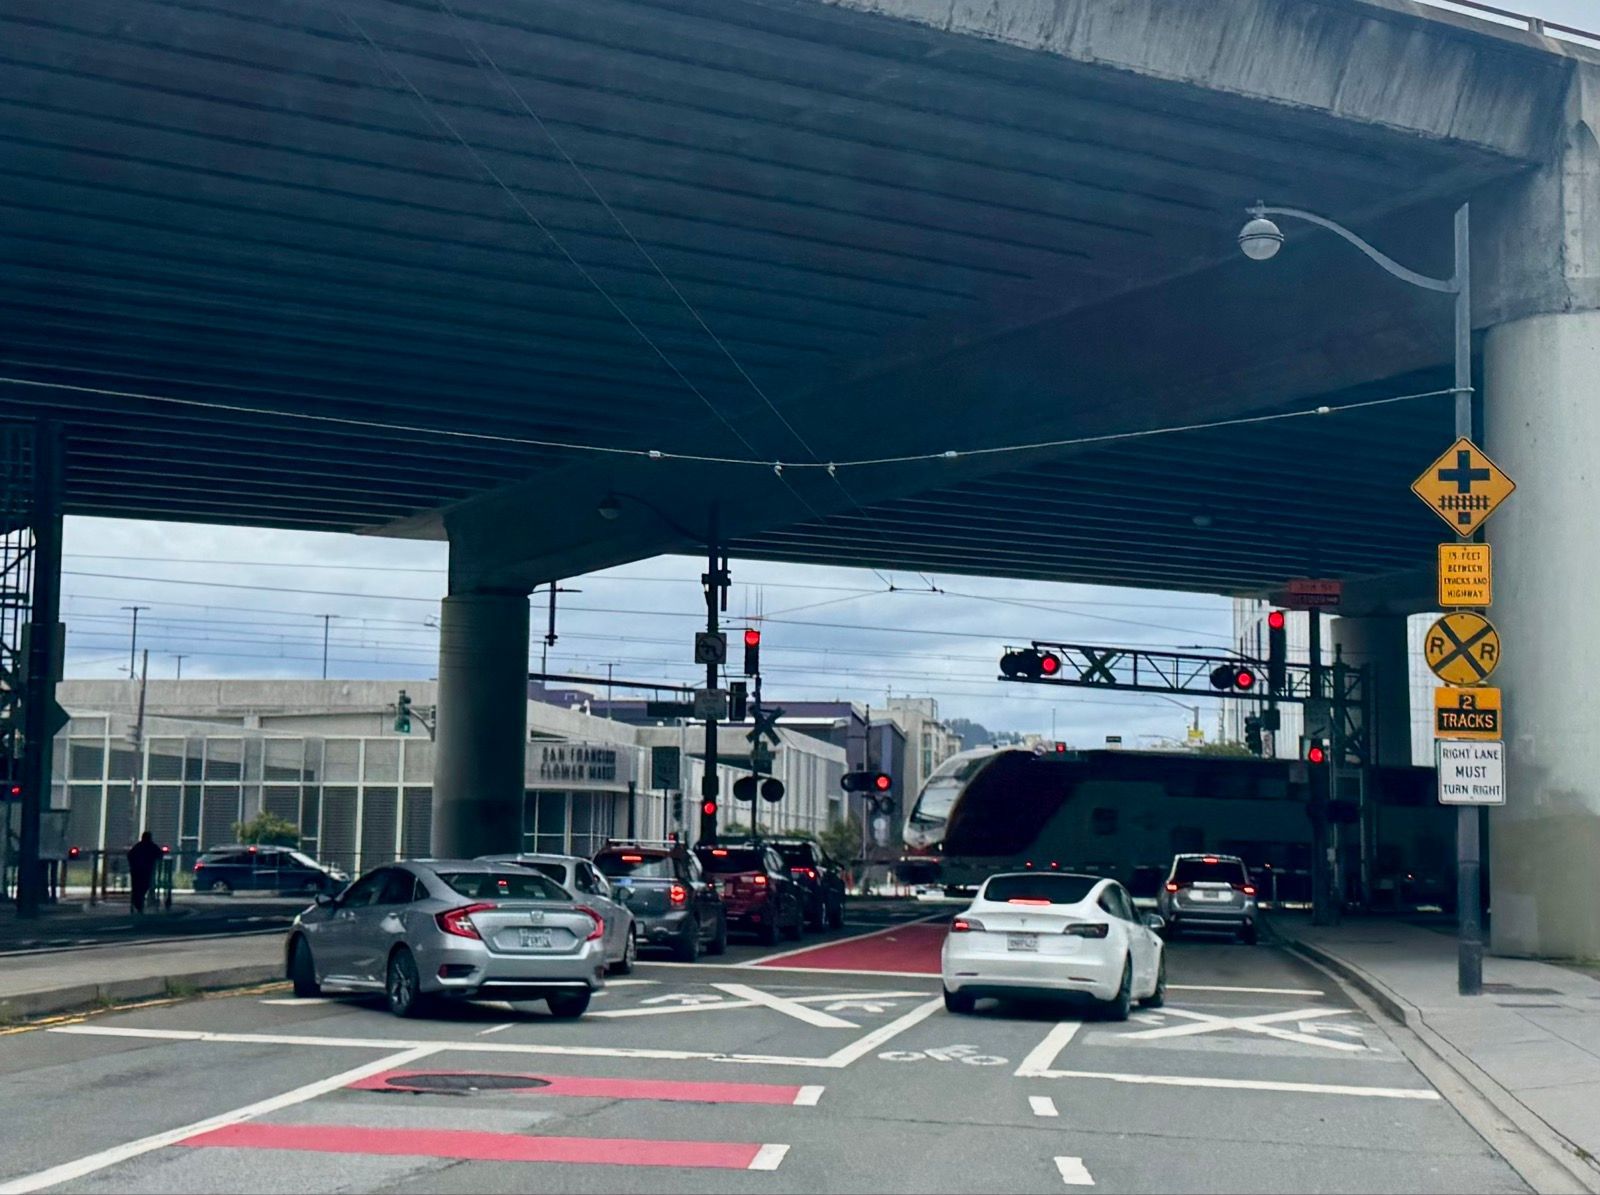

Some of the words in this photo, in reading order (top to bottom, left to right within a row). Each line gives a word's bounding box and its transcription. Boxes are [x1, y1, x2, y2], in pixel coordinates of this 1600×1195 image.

[1447, 564, 1483, 573] BETWEEN
[1444, 577, 1471, 585] TRACKS
[1472, 577, 1488, 585] AND
[1447, 589, 1483, 598] HIGHWAY
[1430, 636, 1445, 655] R
[1480, 642, 1496, 661] R
[1462, 695, 1473, 710] 2
[1441, 713, 1494, 728] TRACKS
[569, 747, 617, 764] FRANCI
[1442, 748, 1470, 760] RIGHT
[1474, 749, 1499, 760] LANE
[1455, 766, 1487, 778] MUST
[1443, 784, 1469, 795] TURN
[1472, 785, 1500, 796] RIGHT
